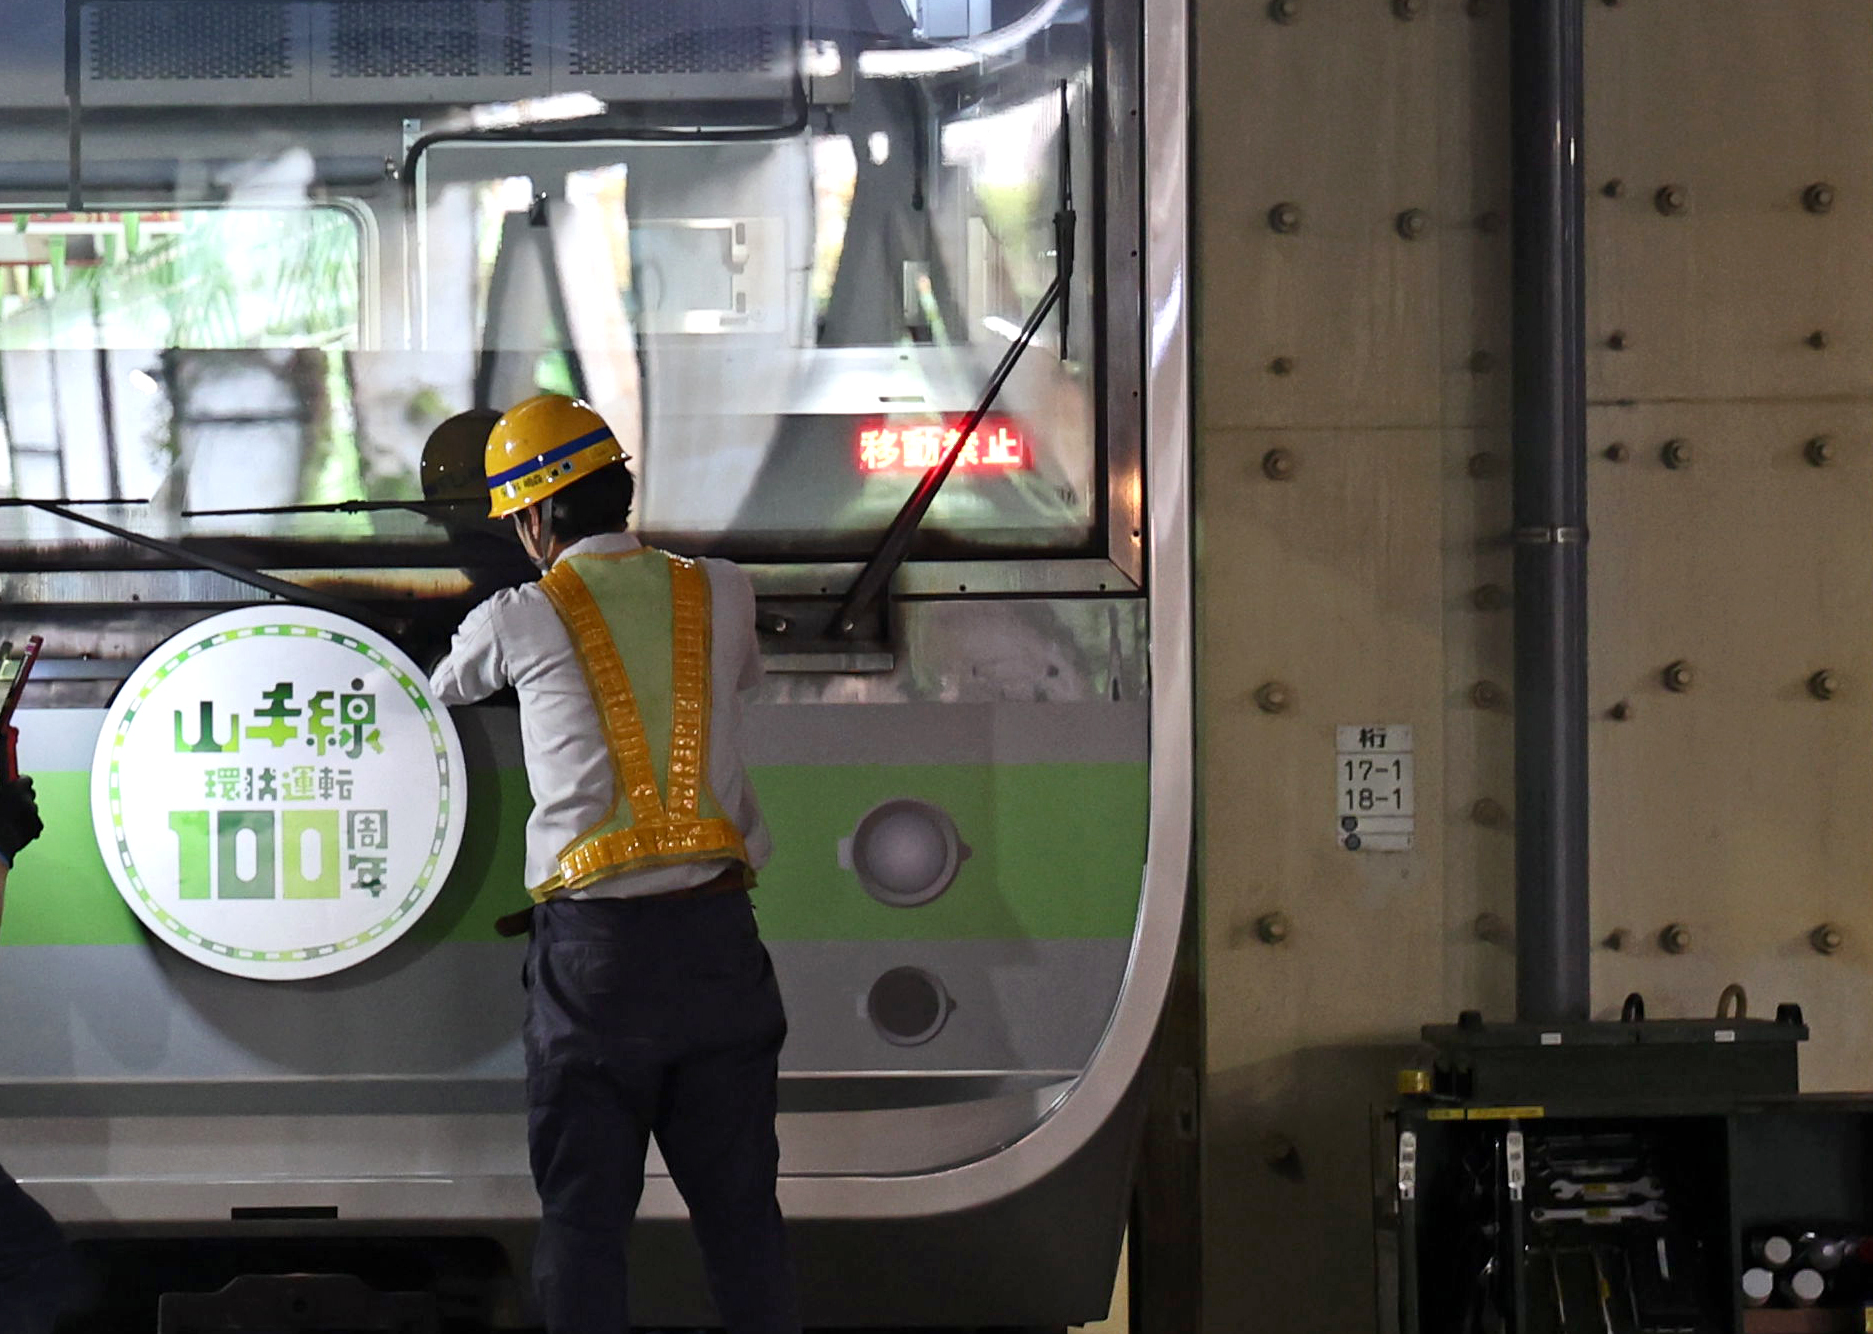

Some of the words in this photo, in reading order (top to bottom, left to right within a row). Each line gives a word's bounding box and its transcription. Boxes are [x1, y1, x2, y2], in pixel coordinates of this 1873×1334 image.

[860, 428, 1021, 469] 移動禁止
[174, 678, 385, 759] 山手線
[204, 766, 354, 801] 環状運転
[1344, 758, 1402, 782] 17-1
[1344, 787, 1402, 810] 18-1
